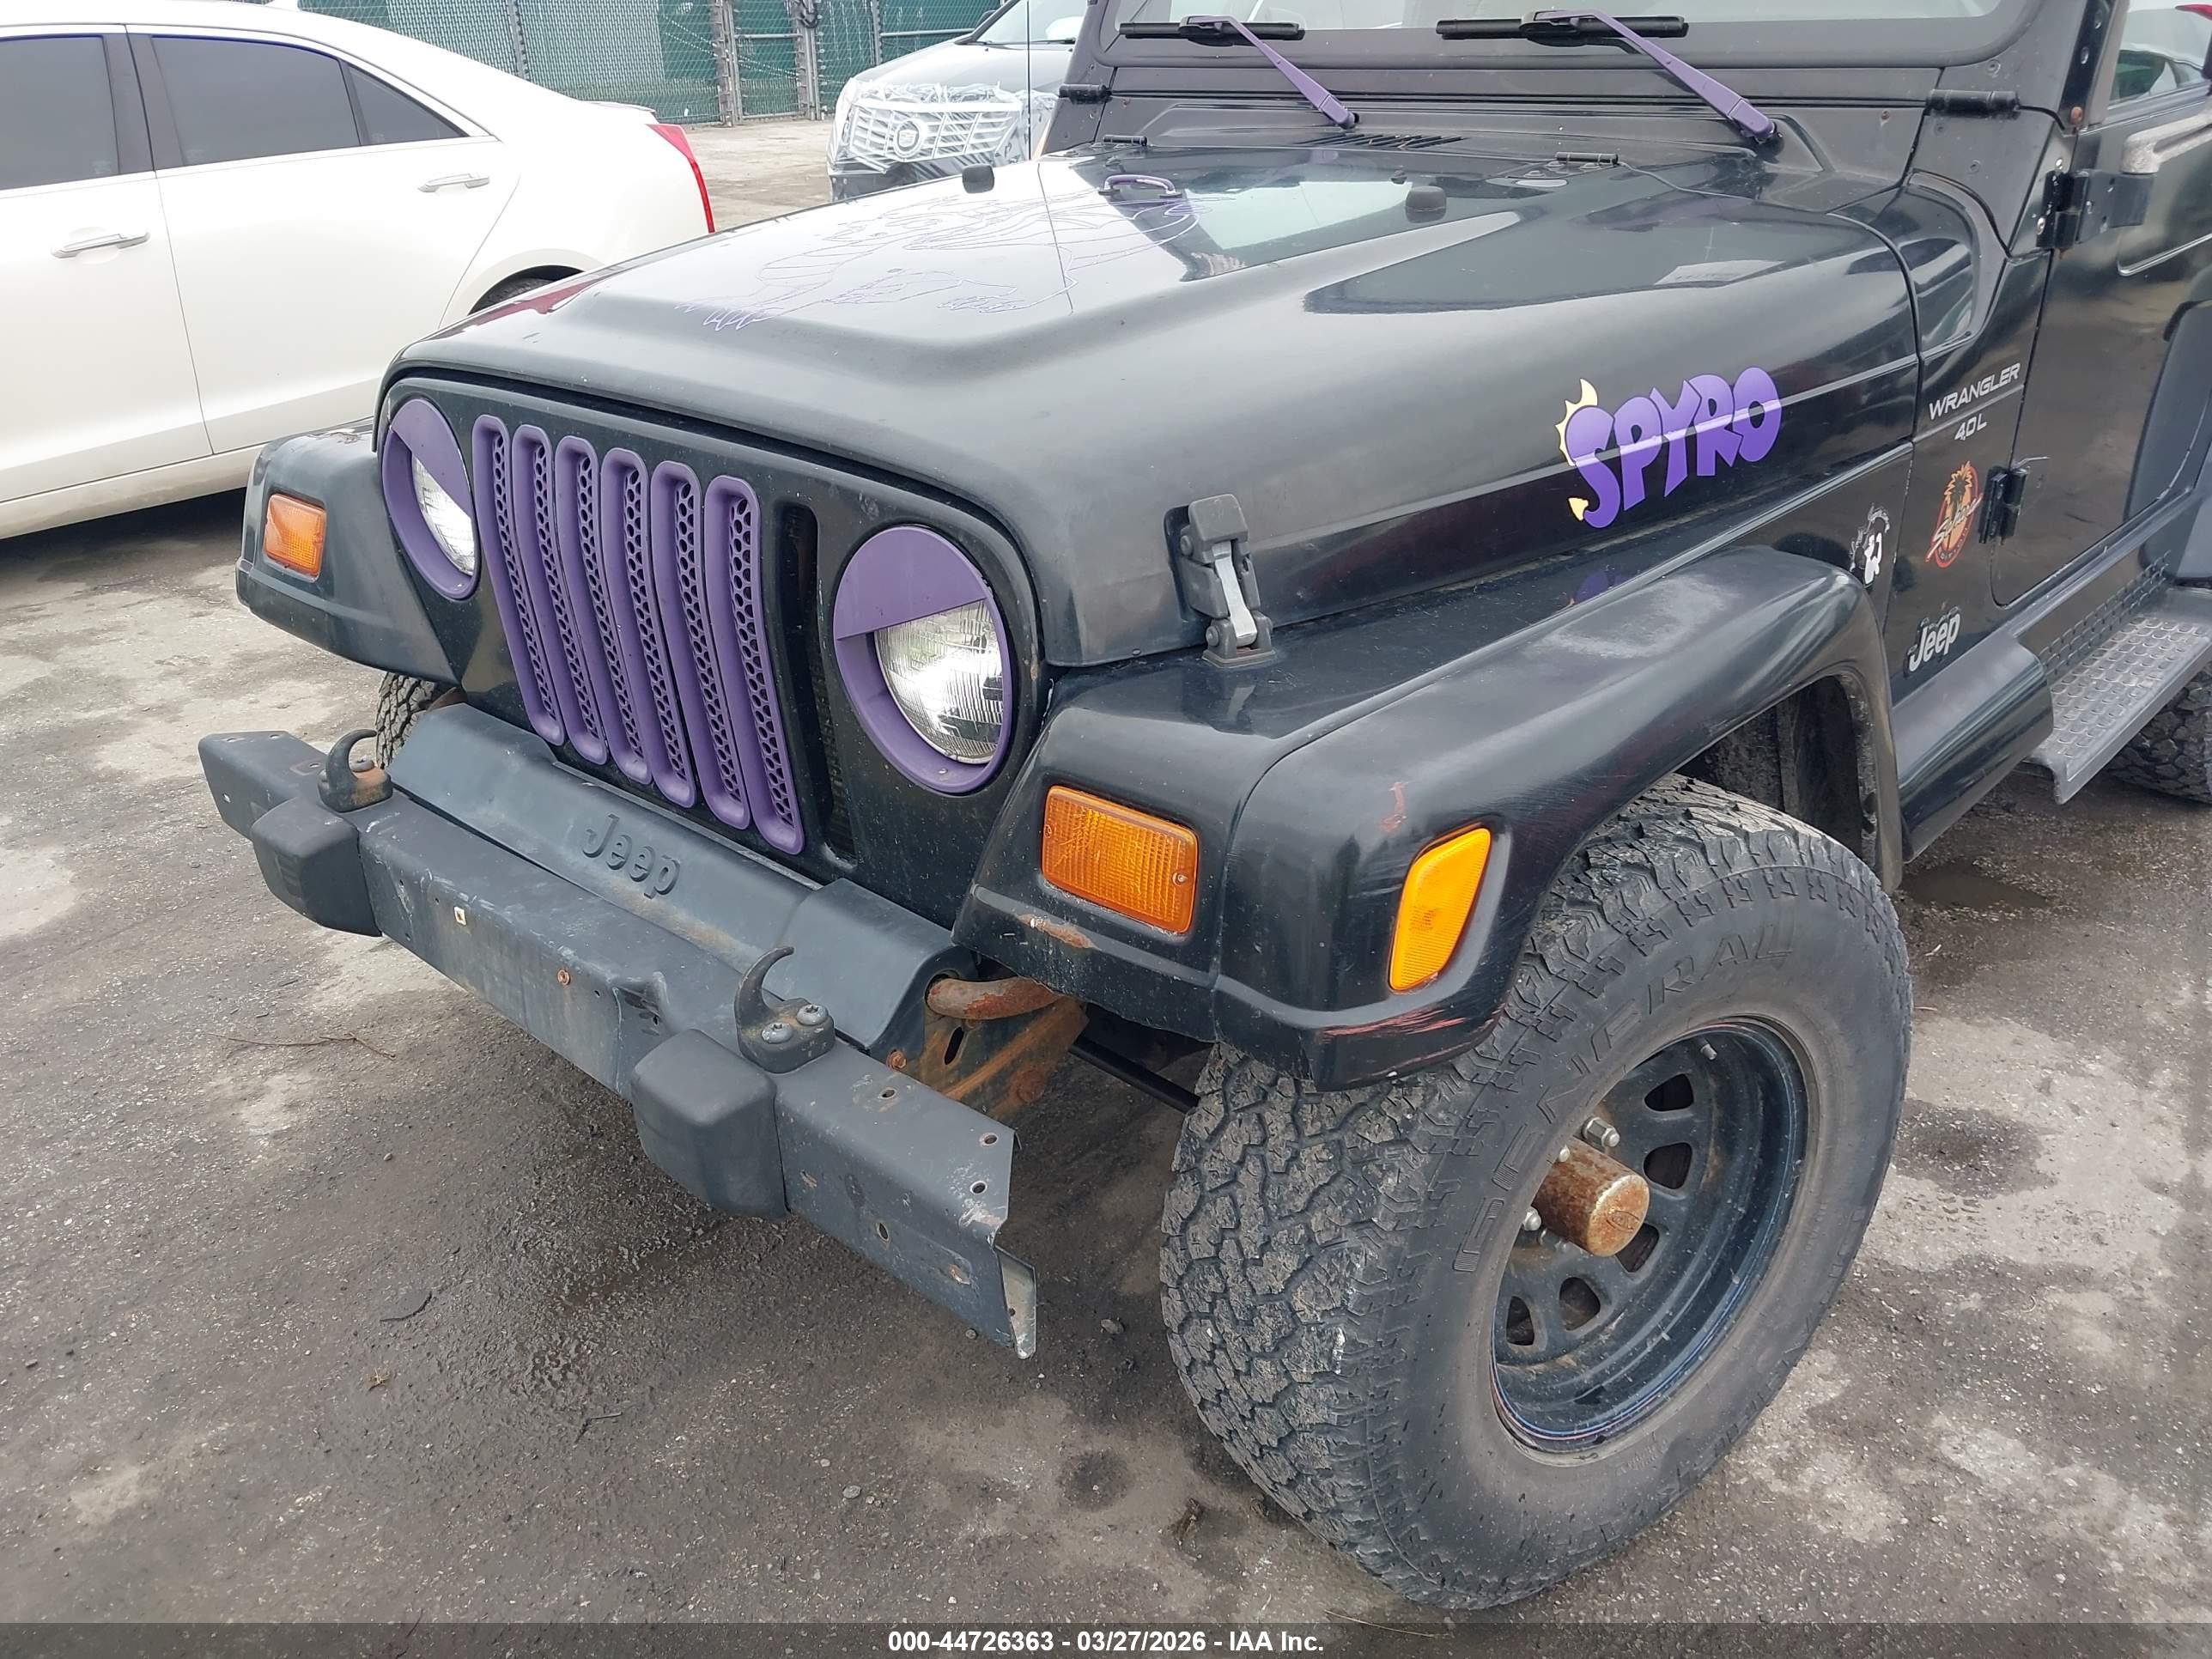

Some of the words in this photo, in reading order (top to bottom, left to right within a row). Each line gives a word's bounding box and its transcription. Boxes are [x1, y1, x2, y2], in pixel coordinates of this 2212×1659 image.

[1929, 362, 2021, 420] WRANGLER
[1564, 367, 1783, 529] SPYRO
[1908, 611, 1961, 672] Jeep
[581, 813, 682, 900] Jeep
